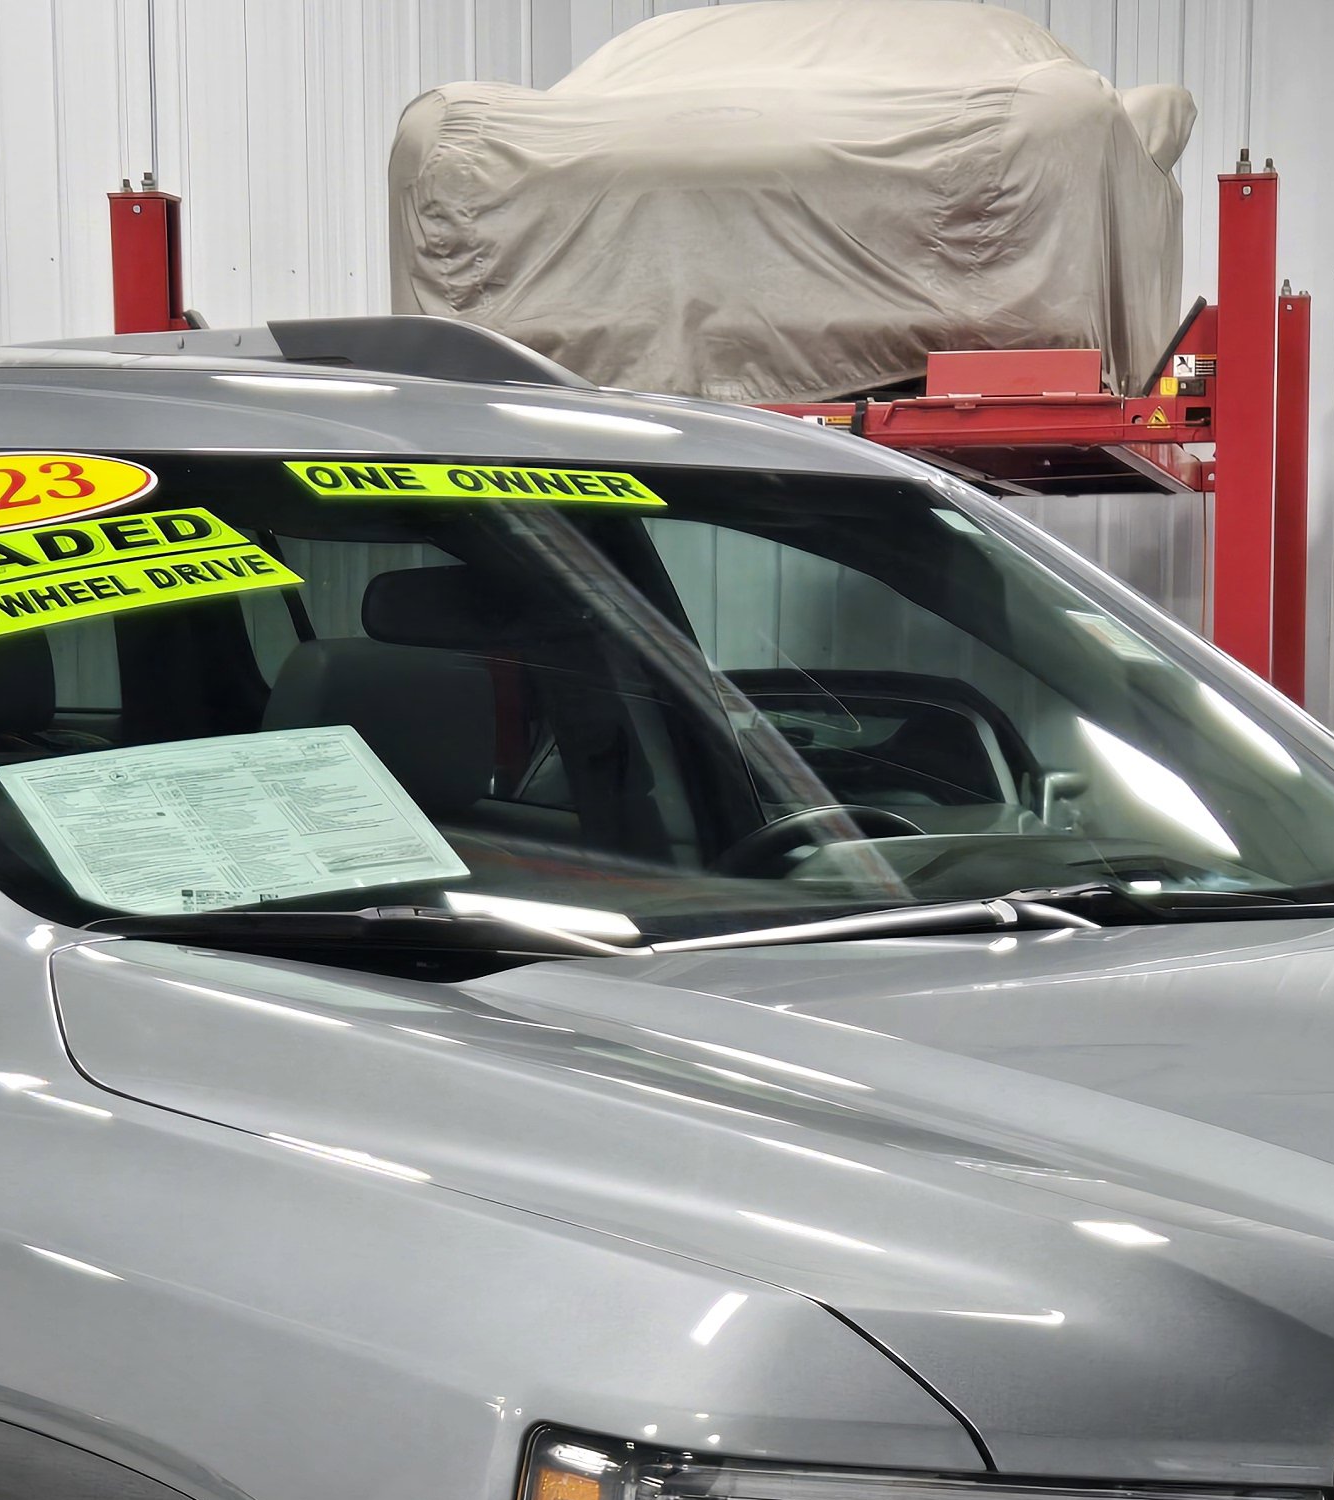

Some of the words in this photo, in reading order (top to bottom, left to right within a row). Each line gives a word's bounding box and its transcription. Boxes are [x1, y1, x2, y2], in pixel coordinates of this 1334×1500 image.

[305, 465, 422, 491] ONE
[447, 467, 647, 499] OWNER
[146, 553, 279, 590] DRIVE
